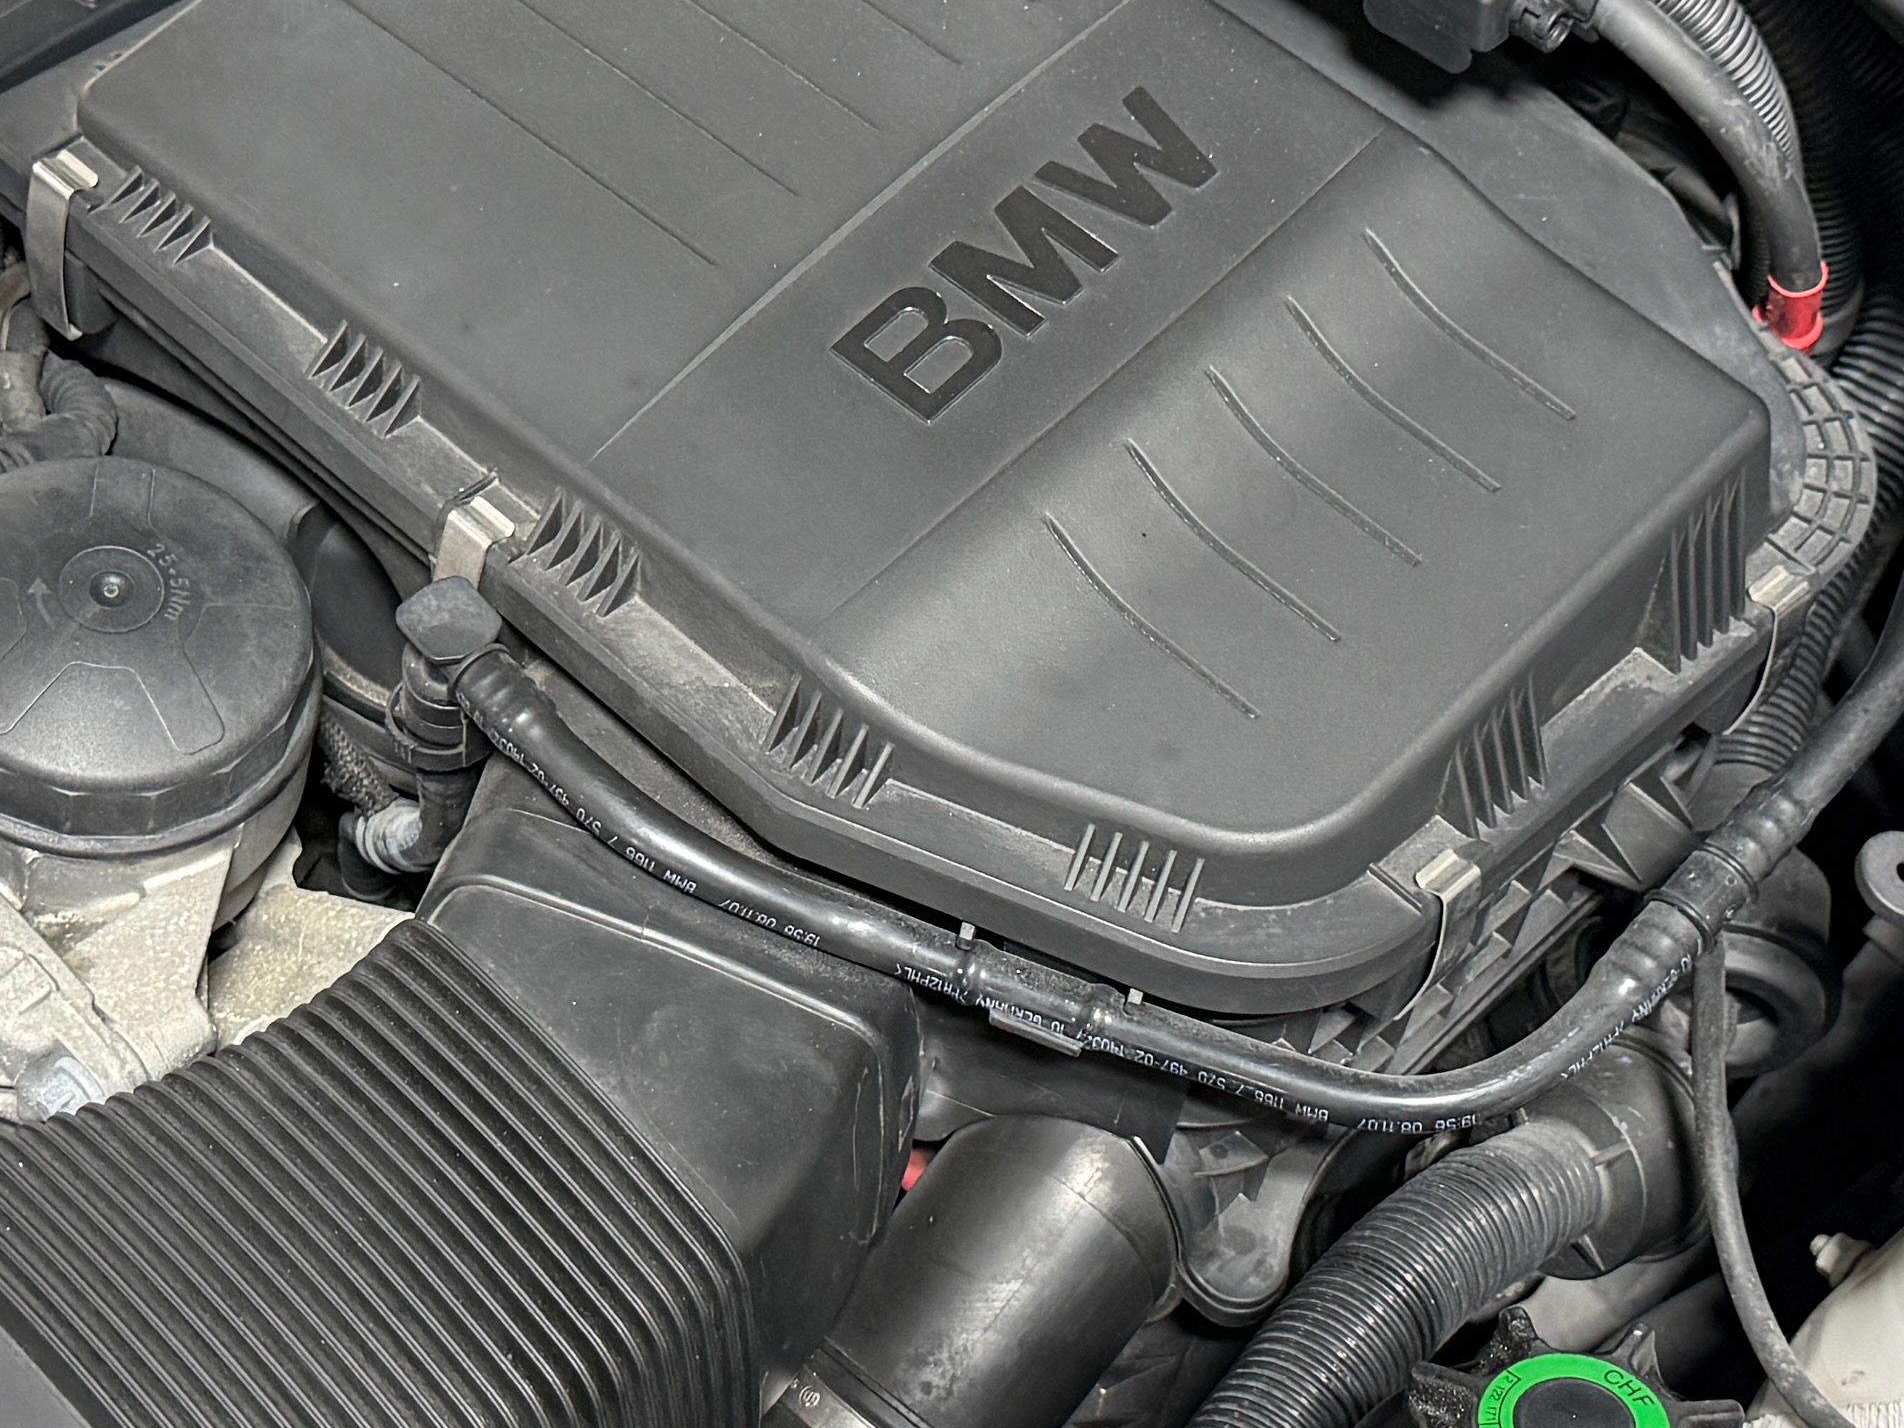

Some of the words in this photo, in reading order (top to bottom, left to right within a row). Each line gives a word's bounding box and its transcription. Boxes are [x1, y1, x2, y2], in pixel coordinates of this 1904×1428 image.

[830, 84, 1221, 425] BMW
[607, 834, 618, 846] 7
[663, 869, 697, 894] BMW
[1134, 1049, 1190, 1078] 497-02
[1197, 1073, 1227, 1091] 570
[1233, 1084, 1245, 1096] 7
[1295, 1105, 1329, 1123] BMW
[1488, 1386, 1506, 1402] 122
[1603, 1369, 1656, 1406] CHF
[1485, 1406, 1498, 1422] 171
